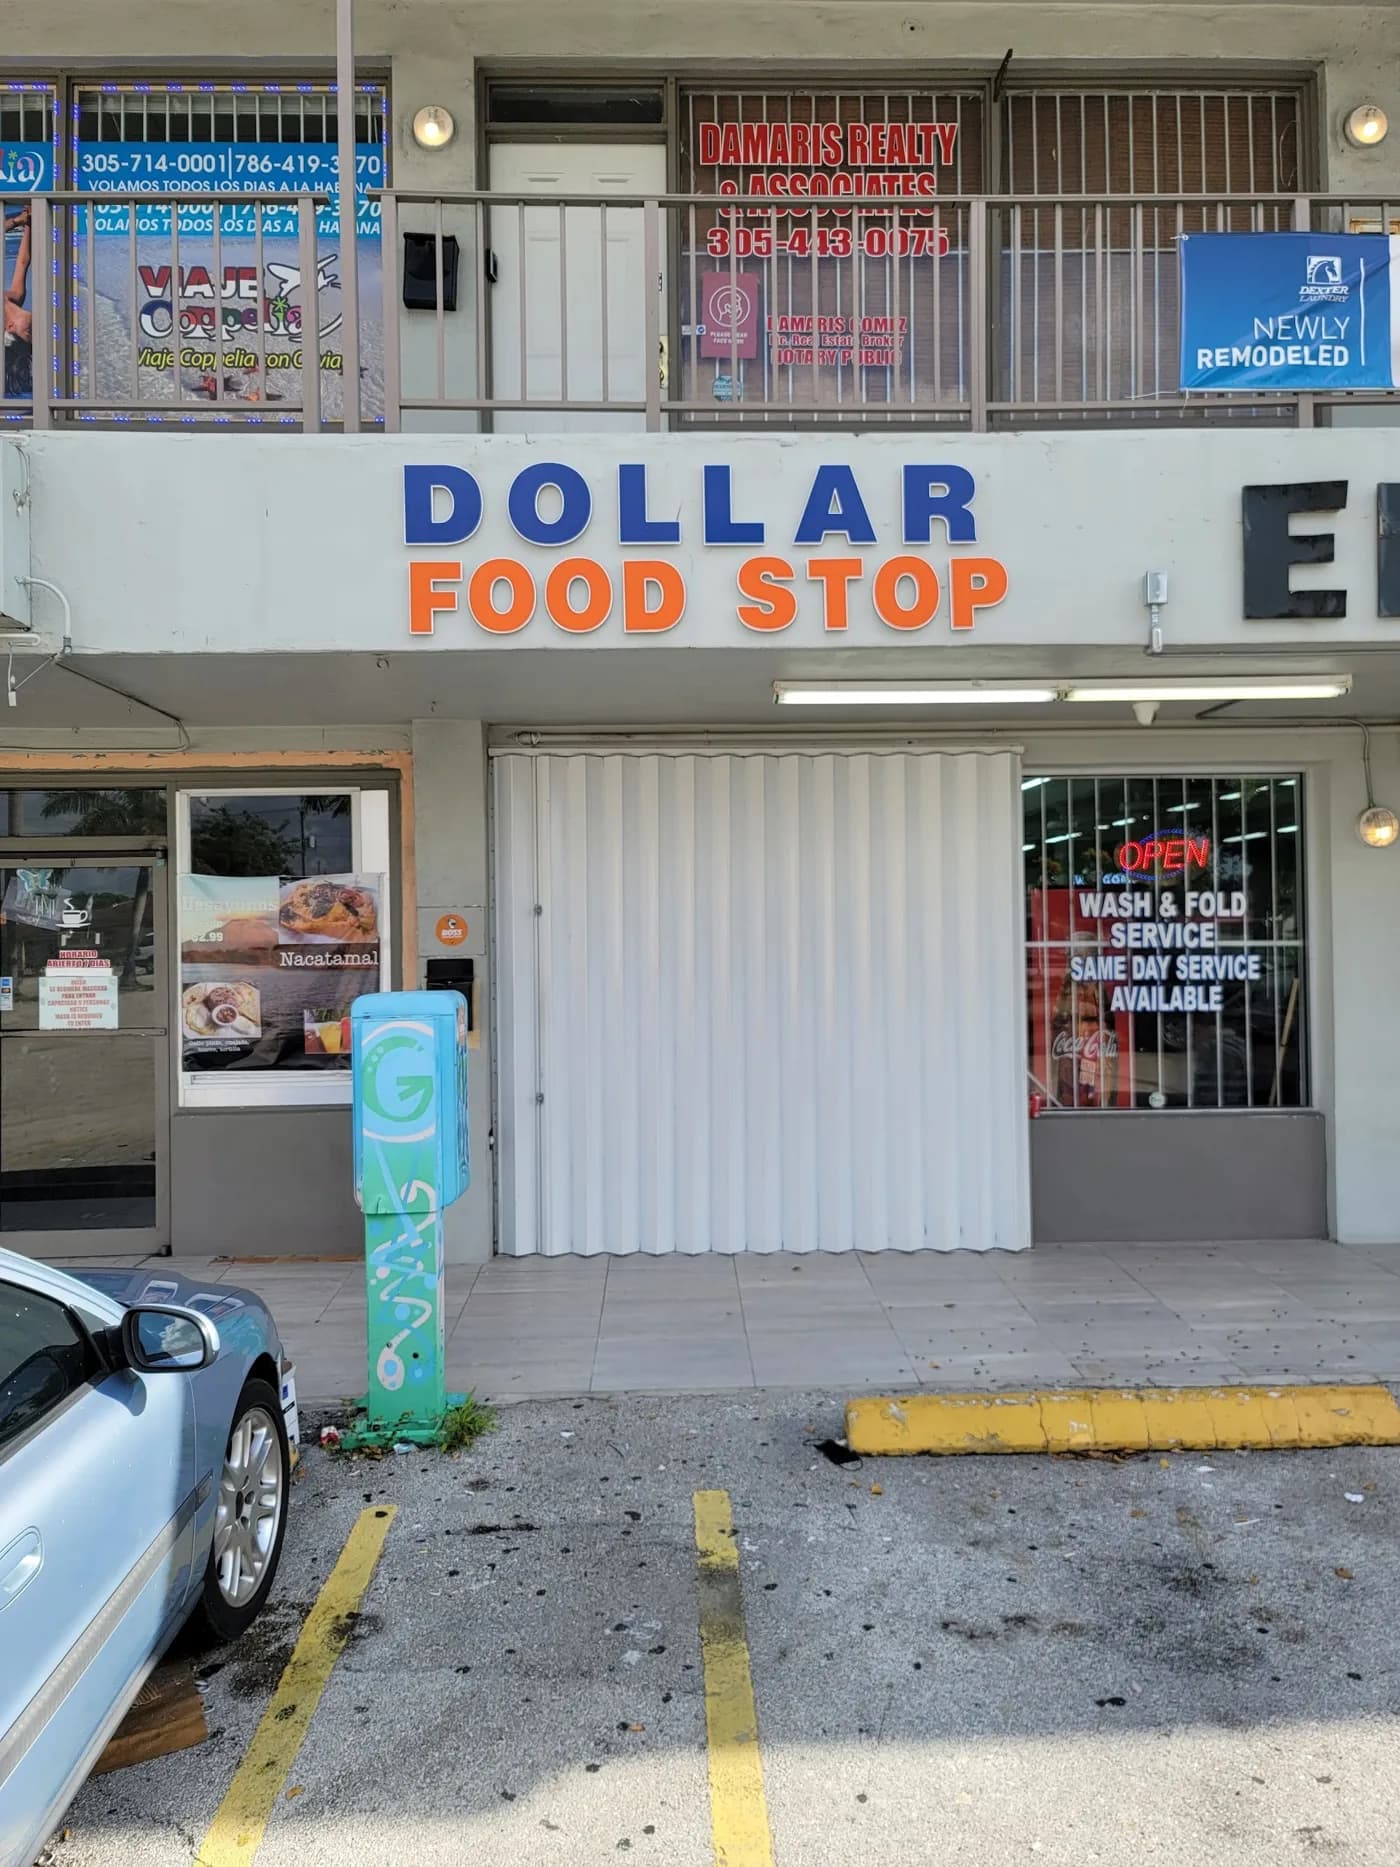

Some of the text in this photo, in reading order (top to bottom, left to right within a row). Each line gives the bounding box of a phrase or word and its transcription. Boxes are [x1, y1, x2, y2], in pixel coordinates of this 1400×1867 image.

[699, 123, 957, 166] DAMARIS REALTY
[235, 154, 380, 174] 786-419-370
[89, 180, 159, 192] VOLAMOS
[163, 180, 210, 192] TODOS
[215, 180, 240, 192] LOS
[244, 181, 275, 192] DIAS
[280, 181, 287, 192] A
[294, 181, 309, 192] LA
[747, 172, 936, 217] ASSOCIATES
[163, 219, 213, 231] TDOS
[246, 220, 281, 232] DAS
[284, 221, 294, 233] A
[707, 228, 949, 257] 305-443-0075
[1299, 285, 1349, 295] DEXTER
[1299, 295, 1349, 303] LAUNDRY
[821, 334, 855, 346] Estat
[1254, 315, 1350, 340] NEWLY
[1197, 345, 1349, 370] REMODELED
[403, 461, 978, 546] DOLLAR
[1242, 480, 1400, 620] E
[408, 555, 1009, 634] FOOD STOP
[1120, 839, 1209, 870] OPEN
[1079, 892, 1247, 918] WASH & FOLD
[1110, 922, 1215, 948] SERVICE
[47, 959, 82, 968] ABIERTO
[89, 959, 111, 968] DIAS
[60, 950, 97, 958] HORARIO
[280, 951, 379, 966] Nacatamal
[1071, 955, 1261, 981] SAME DAY SERVICE
[1110, 985, 1224, 1012] AVAILABLE
